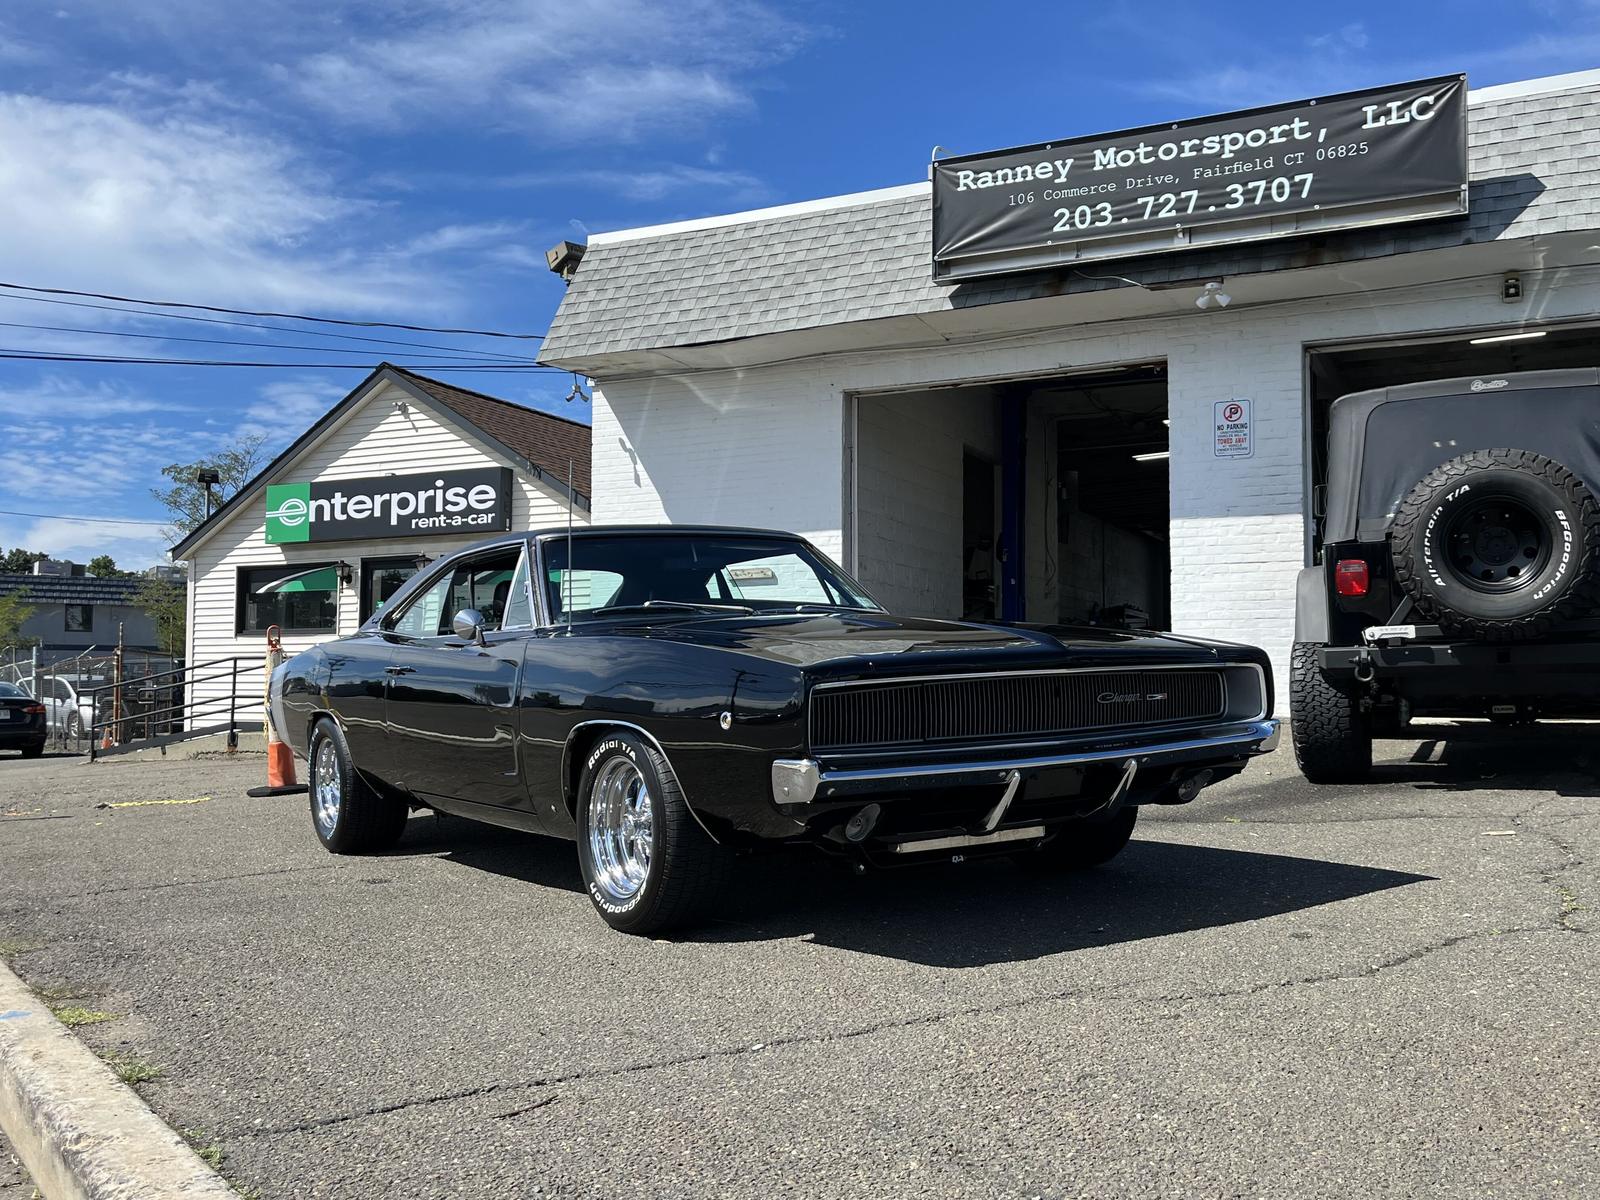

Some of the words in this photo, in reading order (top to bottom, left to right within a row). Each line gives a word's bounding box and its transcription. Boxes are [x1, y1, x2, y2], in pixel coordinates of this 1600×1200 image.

[957, 159, 1074, 191] Ranney
[1093, 117, 1327, 170] Motorsport,
[1362, 96, 1435, 129] LLC
[1009, 191, 1034, 206] 106
[1044, 182, 1117, 201] Commerce
[1126, 174, 1180, 190] Drive,
[1193, 157, 1274, 180] Fairfield
[1284, 152, 1305, 166] CT
[1316, 142, 1369, 161] 06825
[1053, 173, 1314, 233] 203.727.3707
[266, 479, 496, 527] enterprise
[411, 511, 496, 529] rent-a-car
[1424, 506, 1446, 587] All-Terrain
[1446, 484, 1471, 502] T/A
[1533, 509, 1573, 600] BFGoodrich
[588, 740, 619, 770] Radial
